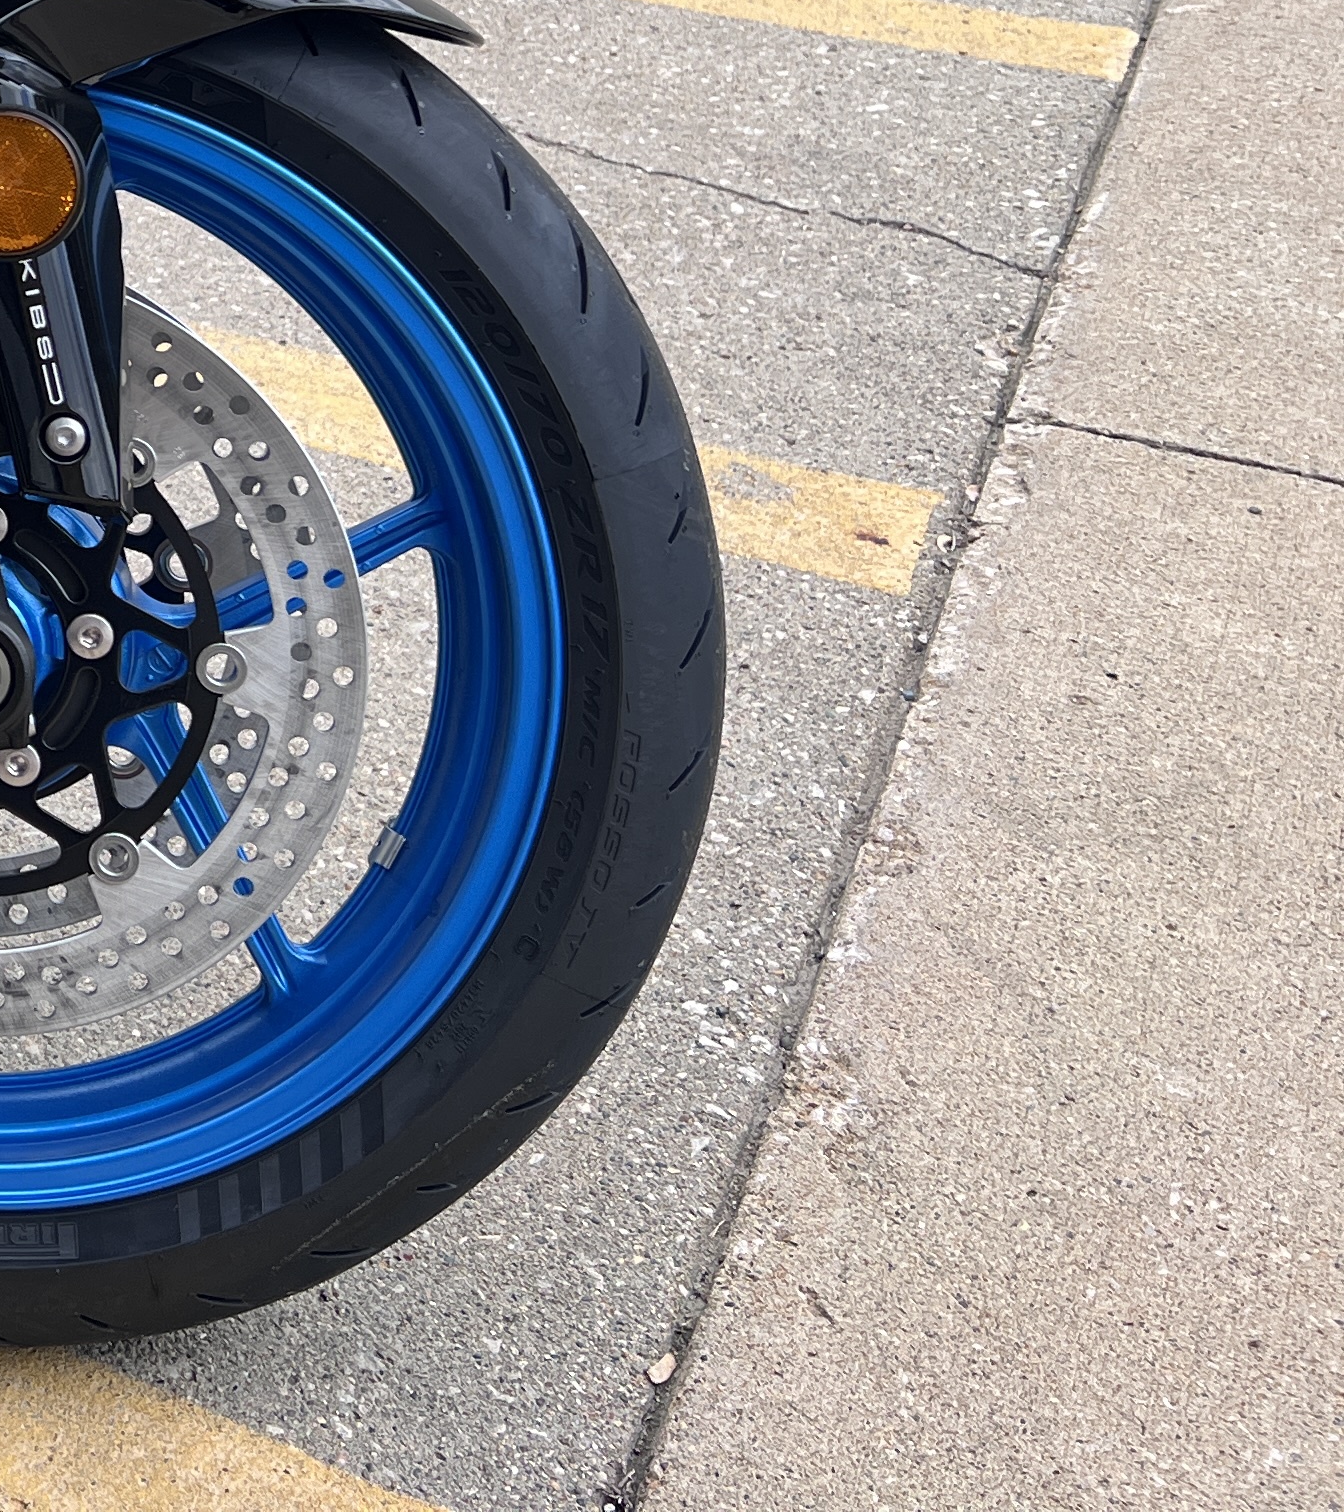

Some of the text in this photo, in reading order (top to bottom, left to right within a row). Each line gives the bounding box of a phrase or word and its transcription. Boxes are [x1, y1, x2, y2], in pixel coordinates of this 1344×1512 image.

[18, 258, 55, 361] KIBS
[439, 268, 572, 468] 120/70
[558, 481, 603, 584] ZR
[580, 592, 610, 661] 17
[577, 676, 602, 768] M/C
